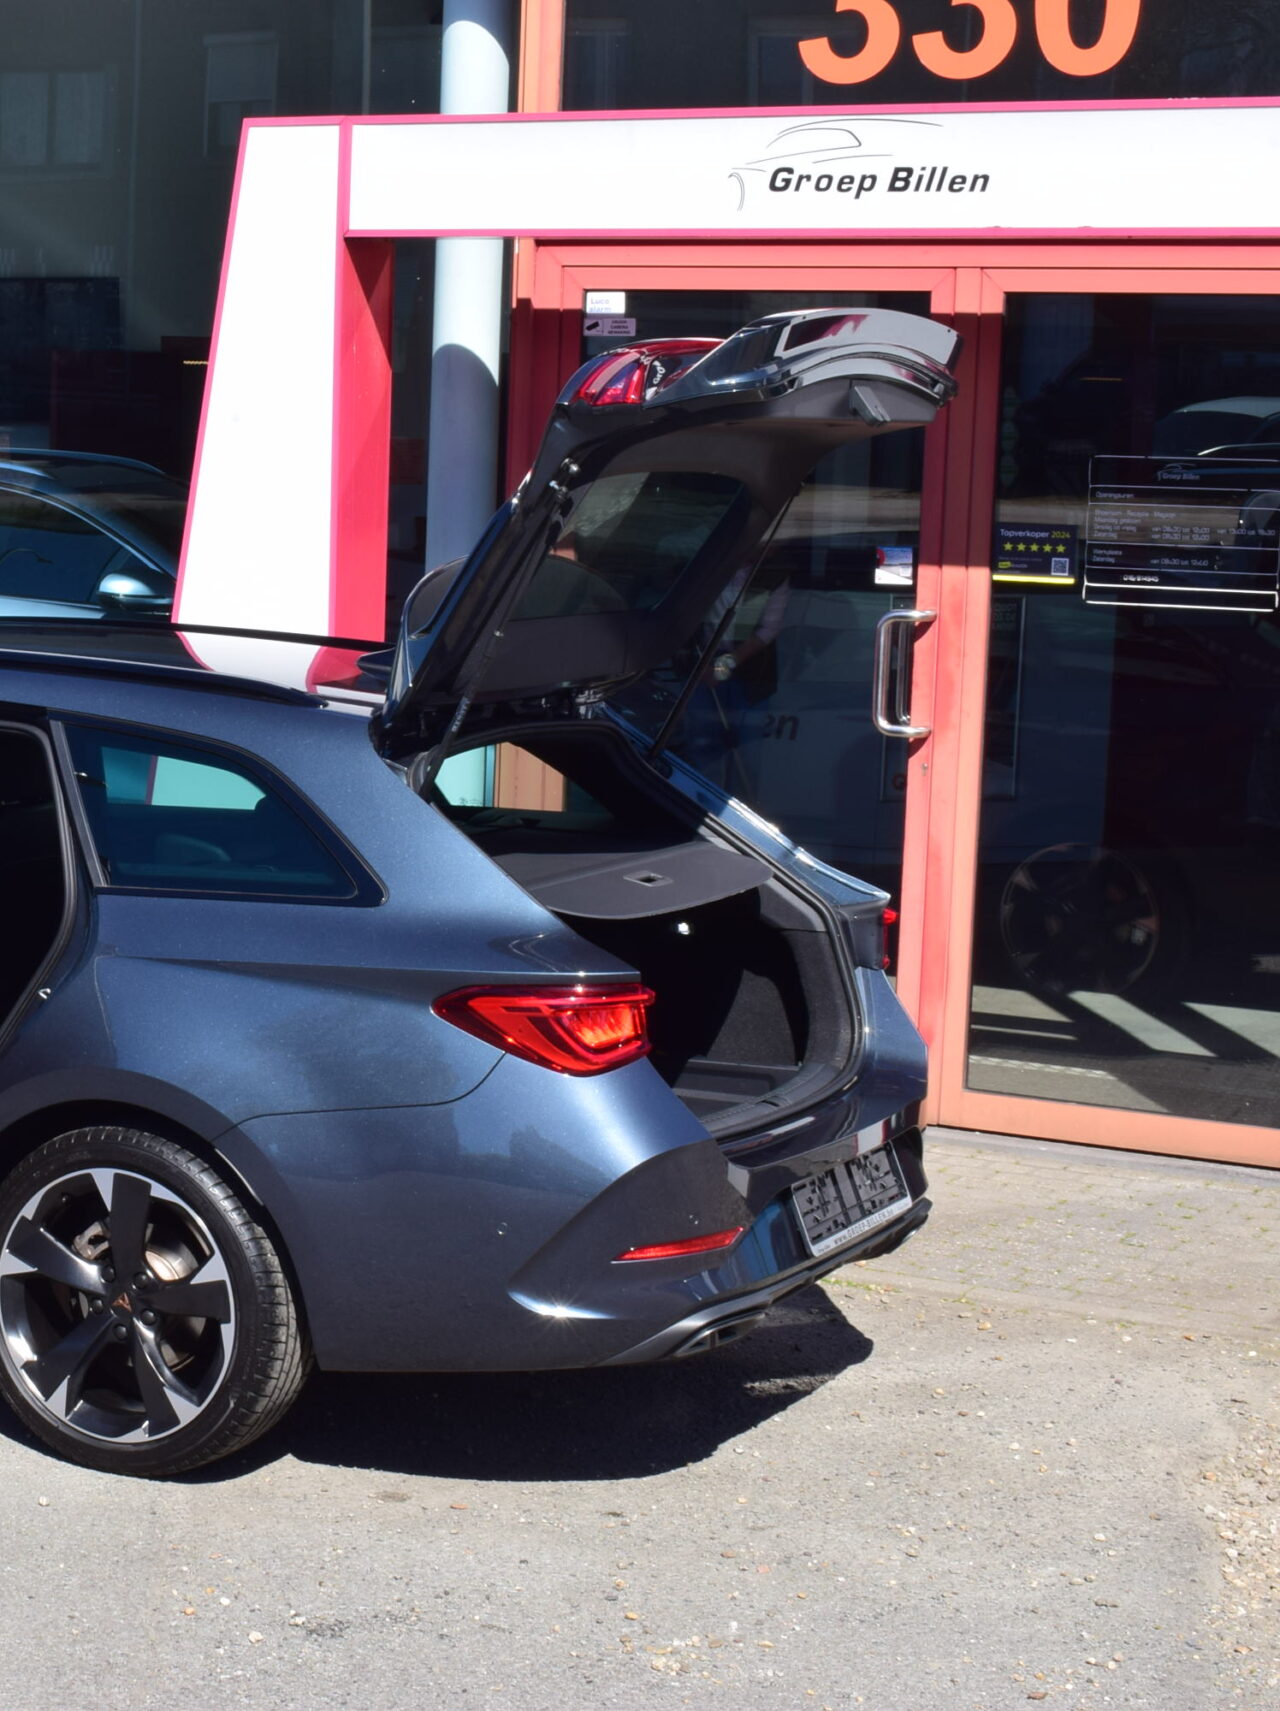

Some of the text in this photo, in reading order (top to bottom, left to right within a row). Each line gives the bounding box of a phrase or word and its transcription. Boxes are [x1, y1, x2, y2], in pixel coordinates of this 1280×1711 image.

[768, 165, 991, 200] Groep Billen
[1000, 528, 1071, 539] Topverkoper 2024
